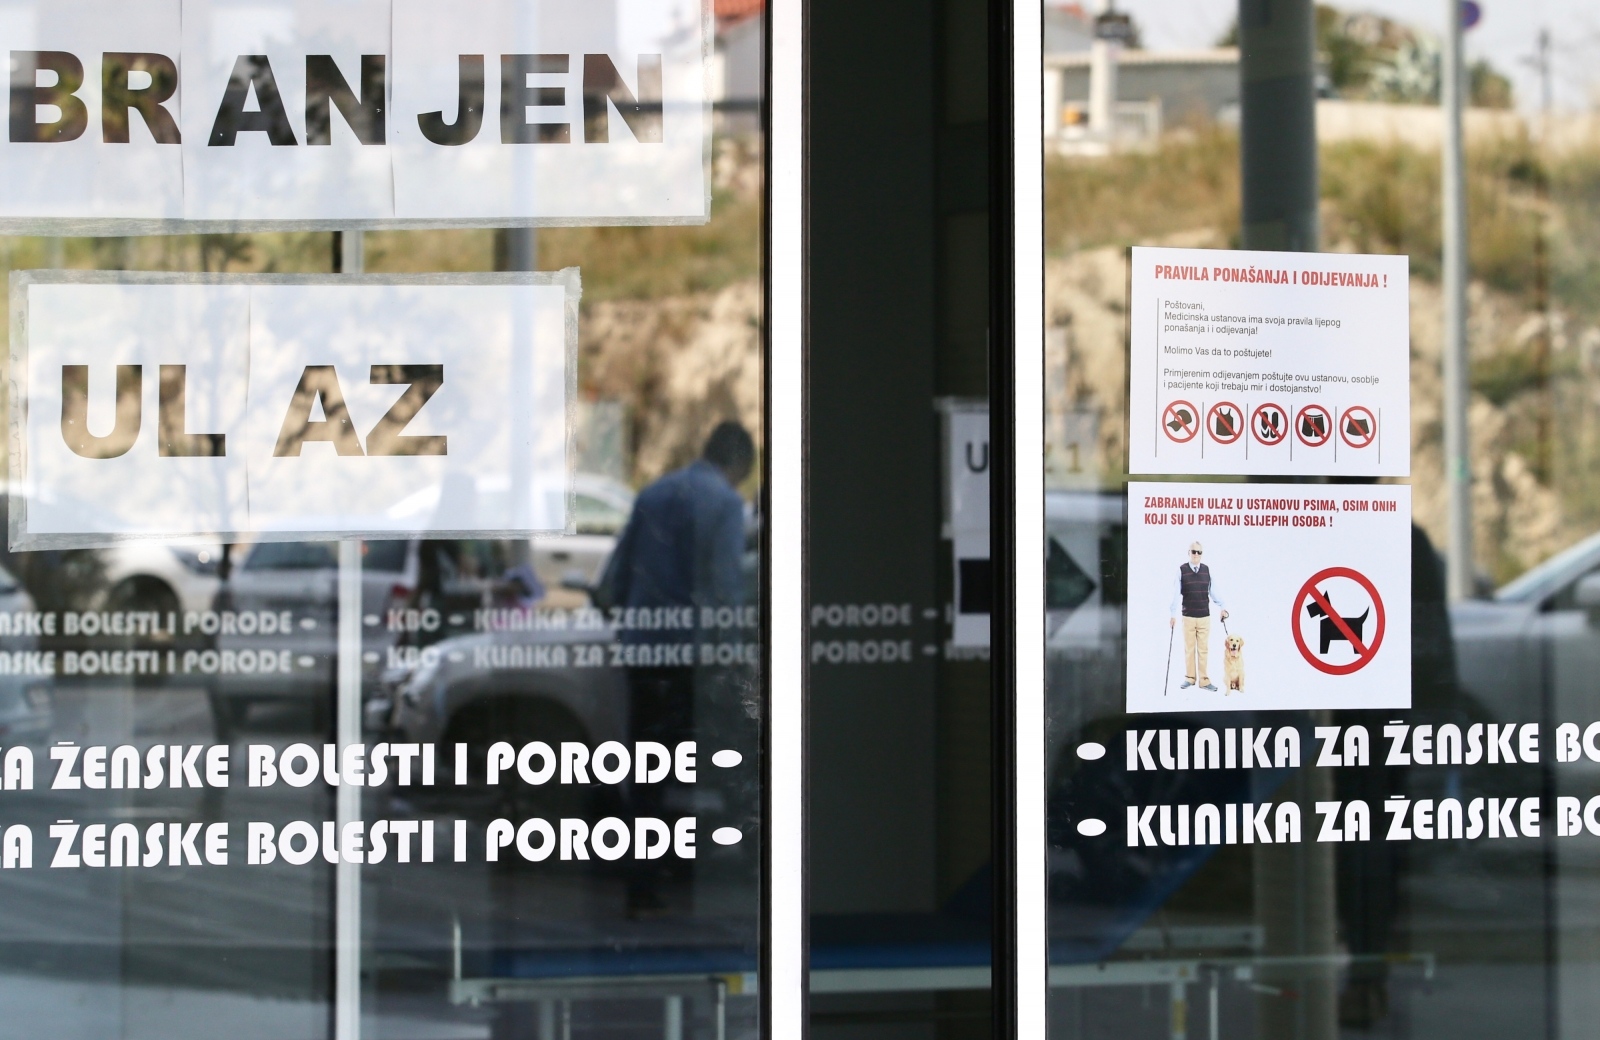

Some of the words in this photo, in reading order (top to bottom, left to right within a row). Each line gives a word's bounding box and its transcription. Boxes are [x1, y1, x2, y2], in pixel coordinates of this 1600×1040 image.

[1155, 264, 1209, 281] PRAVILA
[1214, 265, 1289, 285] PONAŠANJA
[1293, 270, 1297, 285] I
[1301, 270, 1379, 288] ODIJEVANJA
[1164, 300, 1205, 311] Poštovani,
[1164, 312, 1209, 322] Medicinska
[1211, 314, 1247, 323] ustanova
[1249, 315, 1263, 324] ima
[1264, 316, 1286, 326] svoja
[1287, 317, 1313, 326] pravila
[1315, 317, 1341, 328] lijepog
[1164, 323, 1205, 334] ponašanja
[1216, 325, 1258, 336] odijevanja!
[1164, 345, 1193, 355] Molimo
[1195, 347, 1209, 356] Vas
[1211, 347, 1222, 356] da
[1223, 348, 1232, 356] to
[1233, 348, 1272, 359] poštujete!
[1163, 368, 1211, 379] Primjerenim
[1212, 370, 1260, 381] odijevanjem
[1262, 372, 1293, 382] poštujte
[1295, 374, 1310, 382] ovu
[1311, 374, 1349, 384] ustanovu,
[1351, 375, 1380, 386] osoblje
[1168, 380, 1204, 391] pacijente
[1205, 381, 1220, 391] koji
[1221, 382, 1249, 392] trebaju
[1250, 383, 1263, 392] mir
[1269, 383, 1322, 394] dostojanstvo!
[60, 363, 448, 460] ULAZ
[1144, 497, 1204, 509] ZABRANJEN
[1207, 498, 1233, 510] ULAZ
[1236, 498, 1243, 510] U
[1246, 498, 1300, 511] USTANOVU
[1303, 499, 1340, 513] PSIMA,
[1342, 500, 1369, 512] OSIM
[1372, 500, 1397, 512] ONIH
[1144, 513, 1168, 525] KOJI
[1170, 513, 1184, 525] SU
[1187, 514, 1195, 526] U
[1198, 514, 1241, 526] PRATNJI
[1243, 515, 1289, 527] SLIJEPIH
[1292, 515, 1326, 527] OSOBA
[63, 611, 160, 635] BOLESTI
[166, 611, 176, 635] I
[183, 611, 292, 634] PORODE
[811, 603, 912, 627] PORODE
[63, 650, 160, 674] BOLESTI
[166, 650, 176, 674] I
[183, 650, 291, 674] PORODE
[573, 644, 604, 668] ZA
[811, 640, 912, 664] PORODE
[1126, 725, 1301, 771] KLINIKA
[1314, 725, 1370, 768] ZA
[0, 745, 34, 790] A
[248, 742, 435, 788] BOLESTI
[454, 742, 468, 786] I
[486, 740, 697, 786] PORODE
[1127, 801, 1301, 847] KLINIKA
[1315, 799, 1371, 843] ZA
[0, 823, 33, 869] A
[247, 819, 434, 865] BOLESTI
[454, 819, 467, 862] I
[485, 816, 696, 862] PORODE
